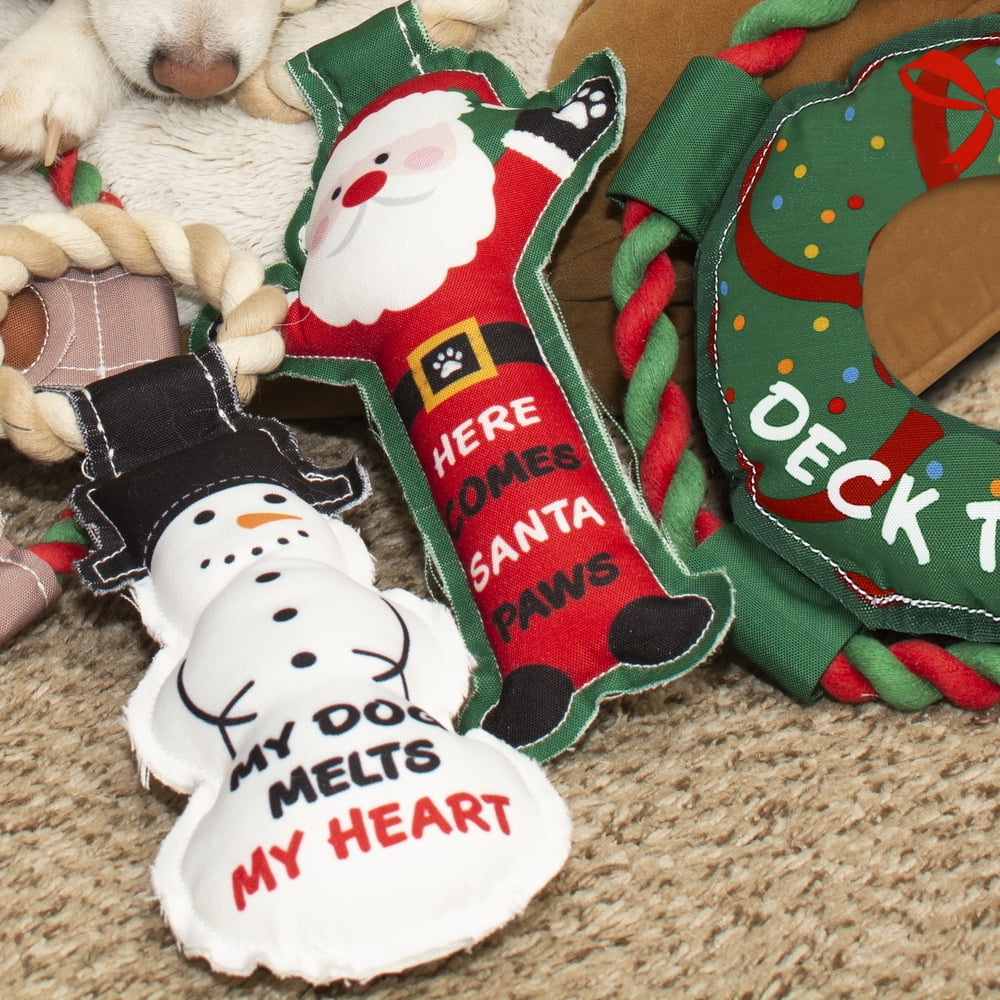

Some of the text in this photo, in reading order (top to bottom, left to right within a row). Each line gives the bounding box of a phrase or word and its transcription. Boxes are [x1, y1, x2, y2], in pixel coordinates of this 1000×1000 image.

[433, 396, 542, 478] HERE
[750, 380, 940, 565] DECK
[445, 443, 582, 541] COMES
[470, 496, 605, 593] SANTA
[491, 551, 620, 644] PAWS
[230, 721, 295, 792] MY
[268, 739, 441, 819] MELTS
[231, 792, 511, 911] MY HEART
